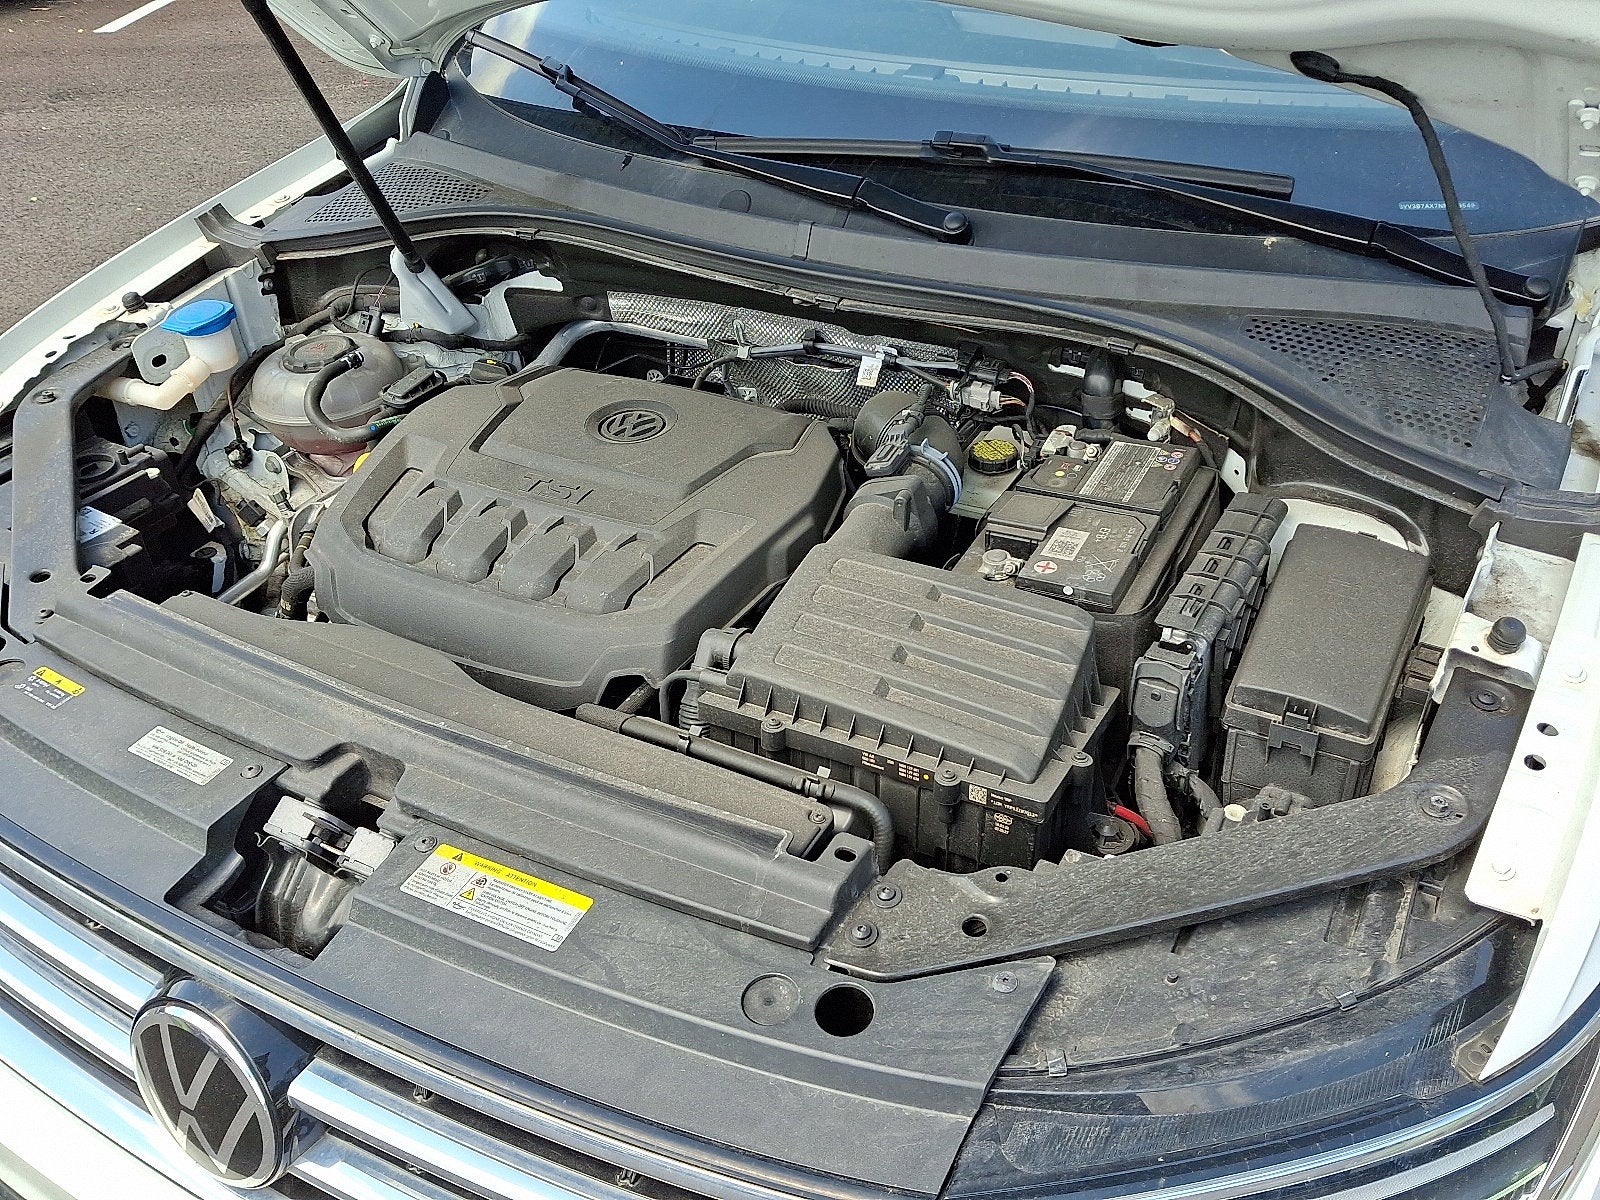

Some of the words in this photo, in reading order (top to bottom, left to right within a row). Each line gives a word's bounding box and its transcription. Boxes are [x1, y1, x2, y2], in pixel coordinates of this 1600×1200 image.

[518, 473, 594, 505] TSI
[474, 860, 502, 875] WARNING
[505, 872, 538, 888] ATTENTION
[132, 1005, 275, 1182] VW
